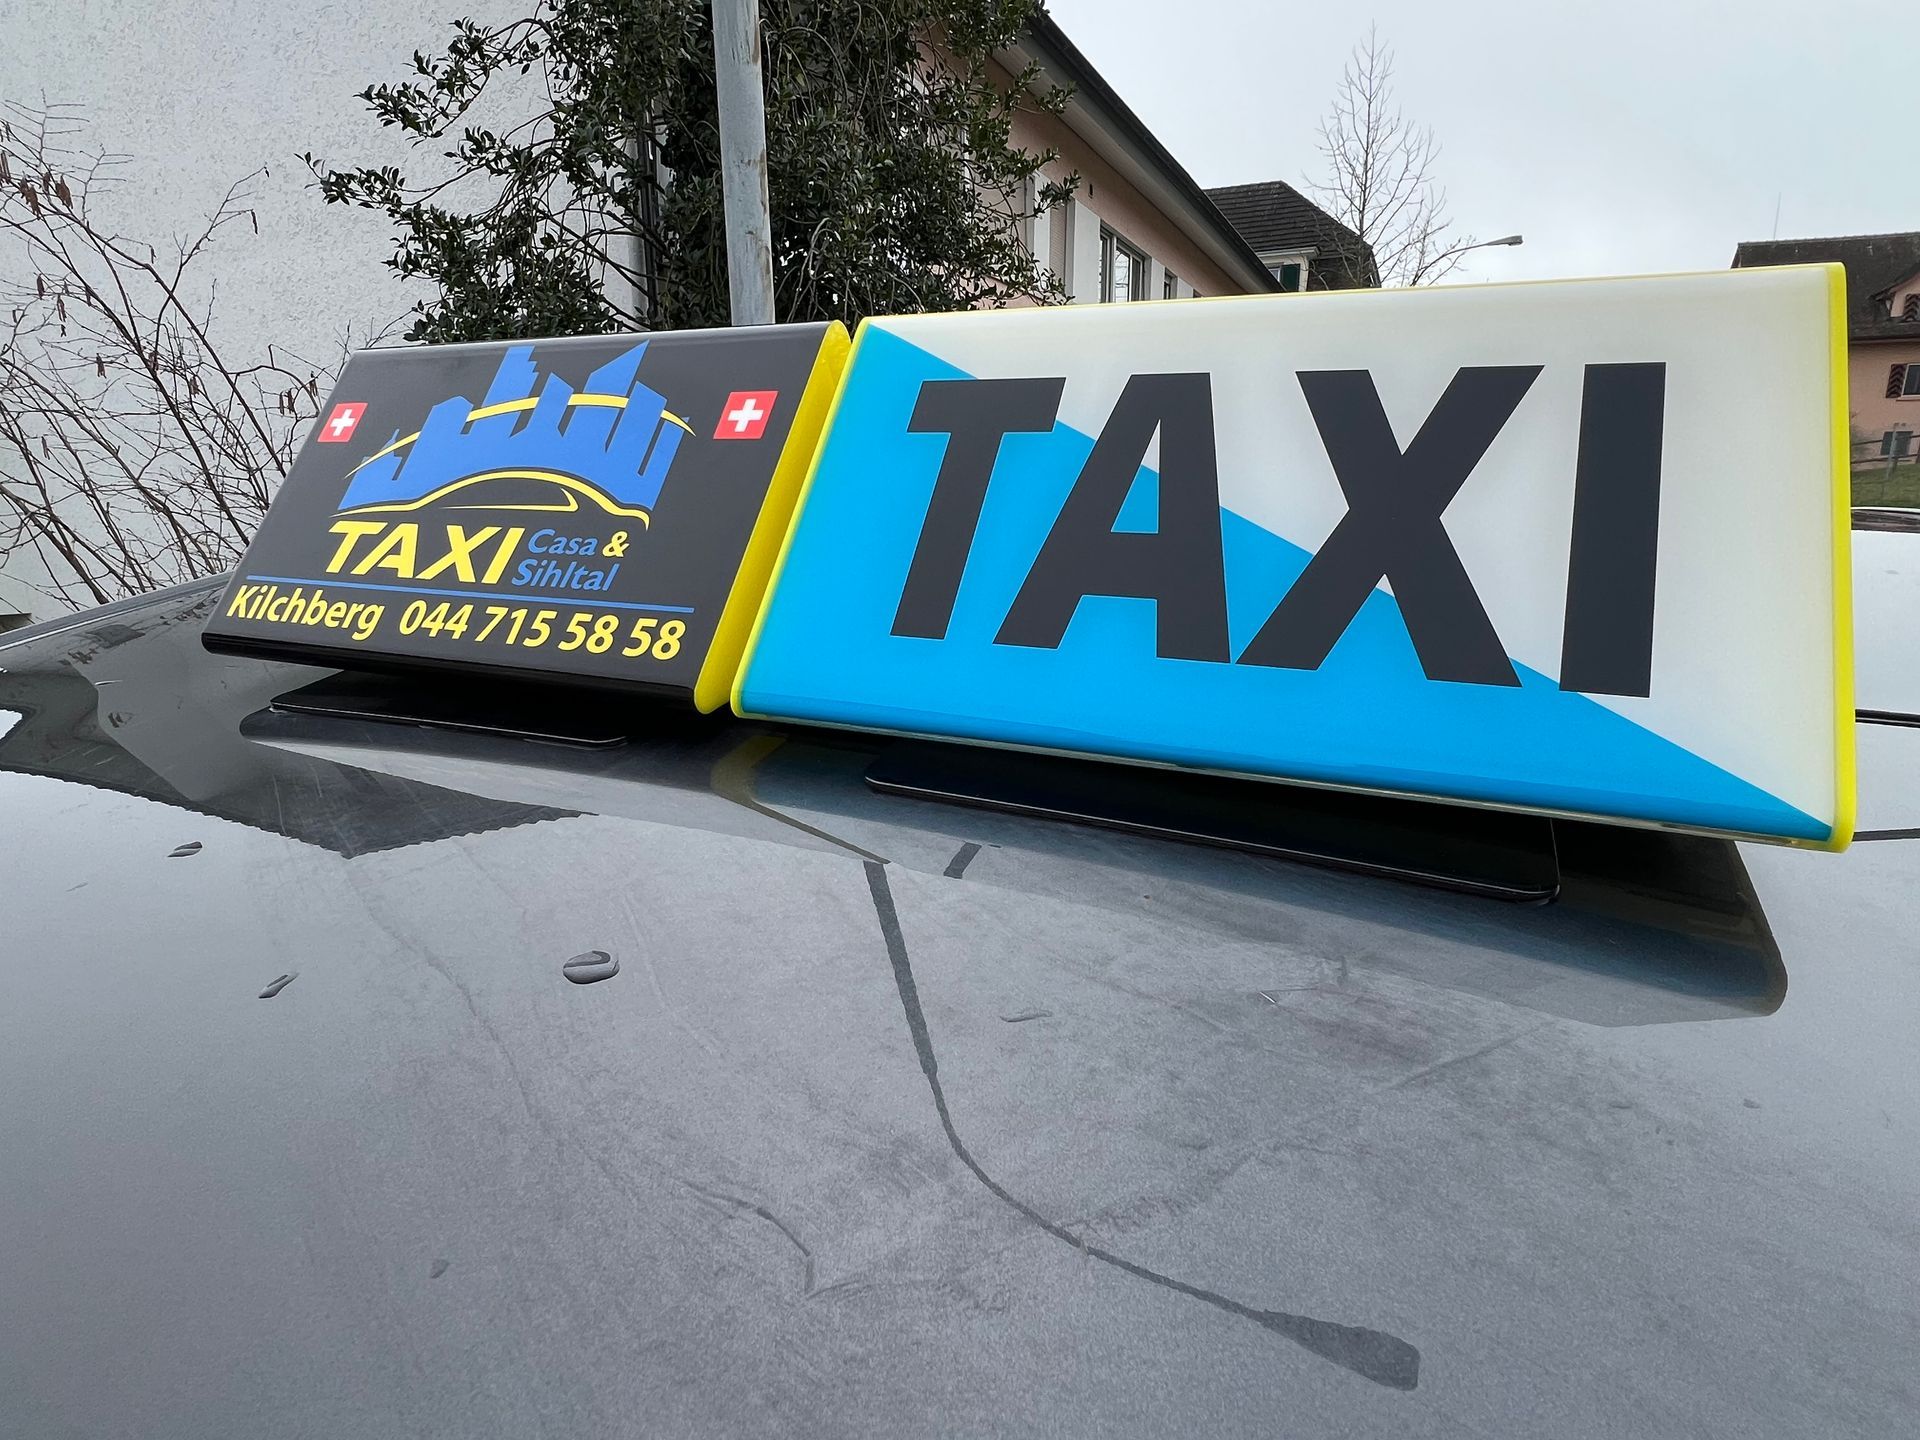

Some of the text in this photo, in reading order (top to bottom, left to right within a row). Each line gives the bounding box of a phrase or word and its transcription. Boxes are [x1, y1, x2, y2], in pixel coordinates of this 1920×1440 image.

[325, 520, 525, 584] TAXI
[527, 528, 630, 559] Casa &
[889, 362, 1667, 698] TAXI
[511, 559, 621, 592] Sihltal
[226, 585, 686, 661] Kilchberg 044 715 58 58
